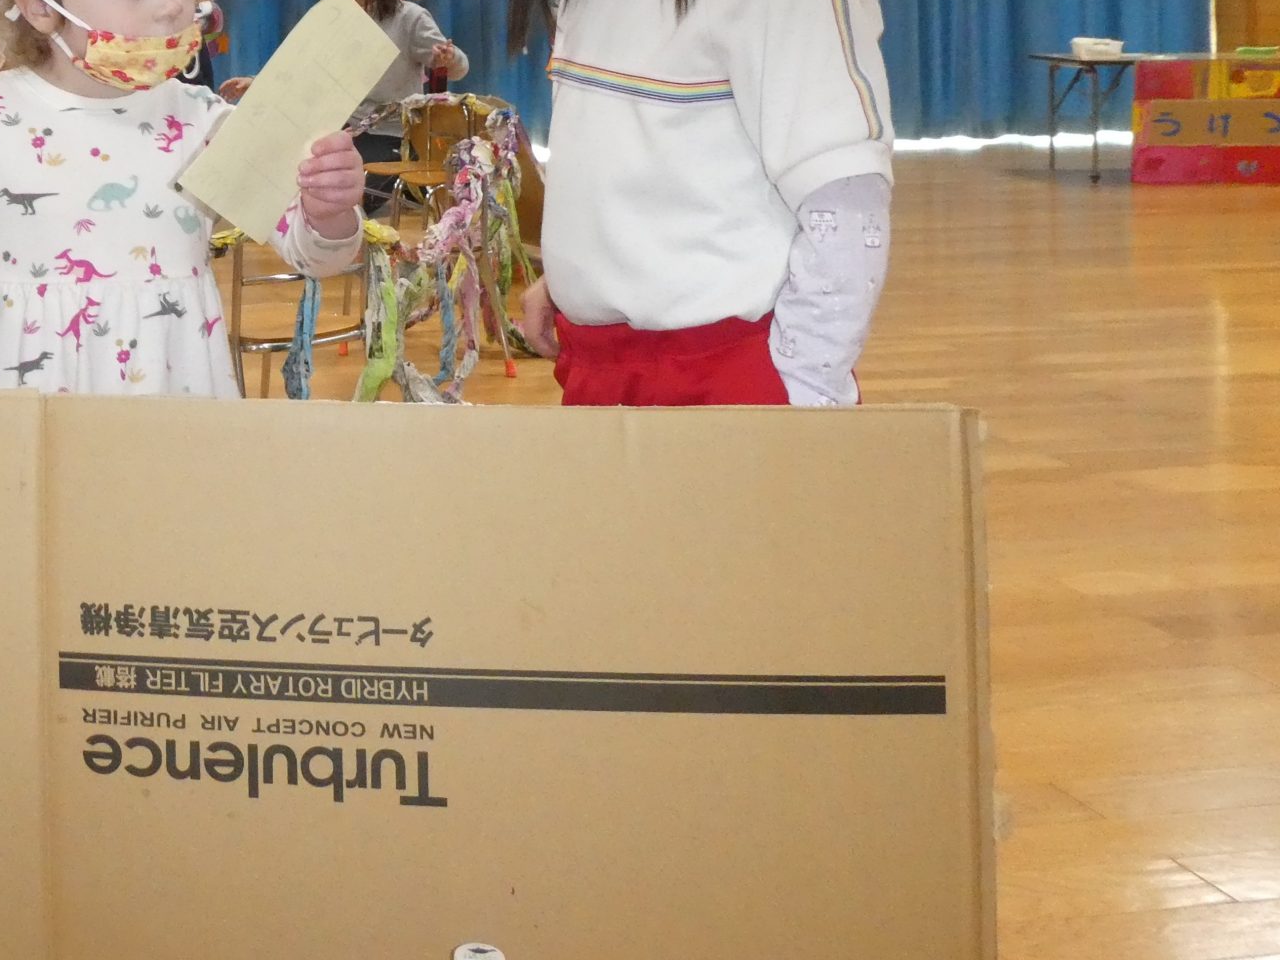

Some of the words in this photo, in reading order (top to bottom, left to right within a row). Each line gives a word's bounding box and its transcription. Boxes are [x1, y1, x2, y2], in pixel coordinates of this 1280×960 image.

[79, 602, 434, 648] タービュランス空気清浄機
[94, 664, 138, 689] 搭載
[145, 669, 223, 694] FILTER
[232, 672, 332, 698] ROTARY
[341, 677, 429, 701] HYBRID
[81, 707, 187, 730] PURIFIER
[200, 715, 239, 732] AIR
[251, 717, 366, 738] CONCEPT
[379, 723, 435, 741] NEW
[82, 734, 449, 808] Turbulence
